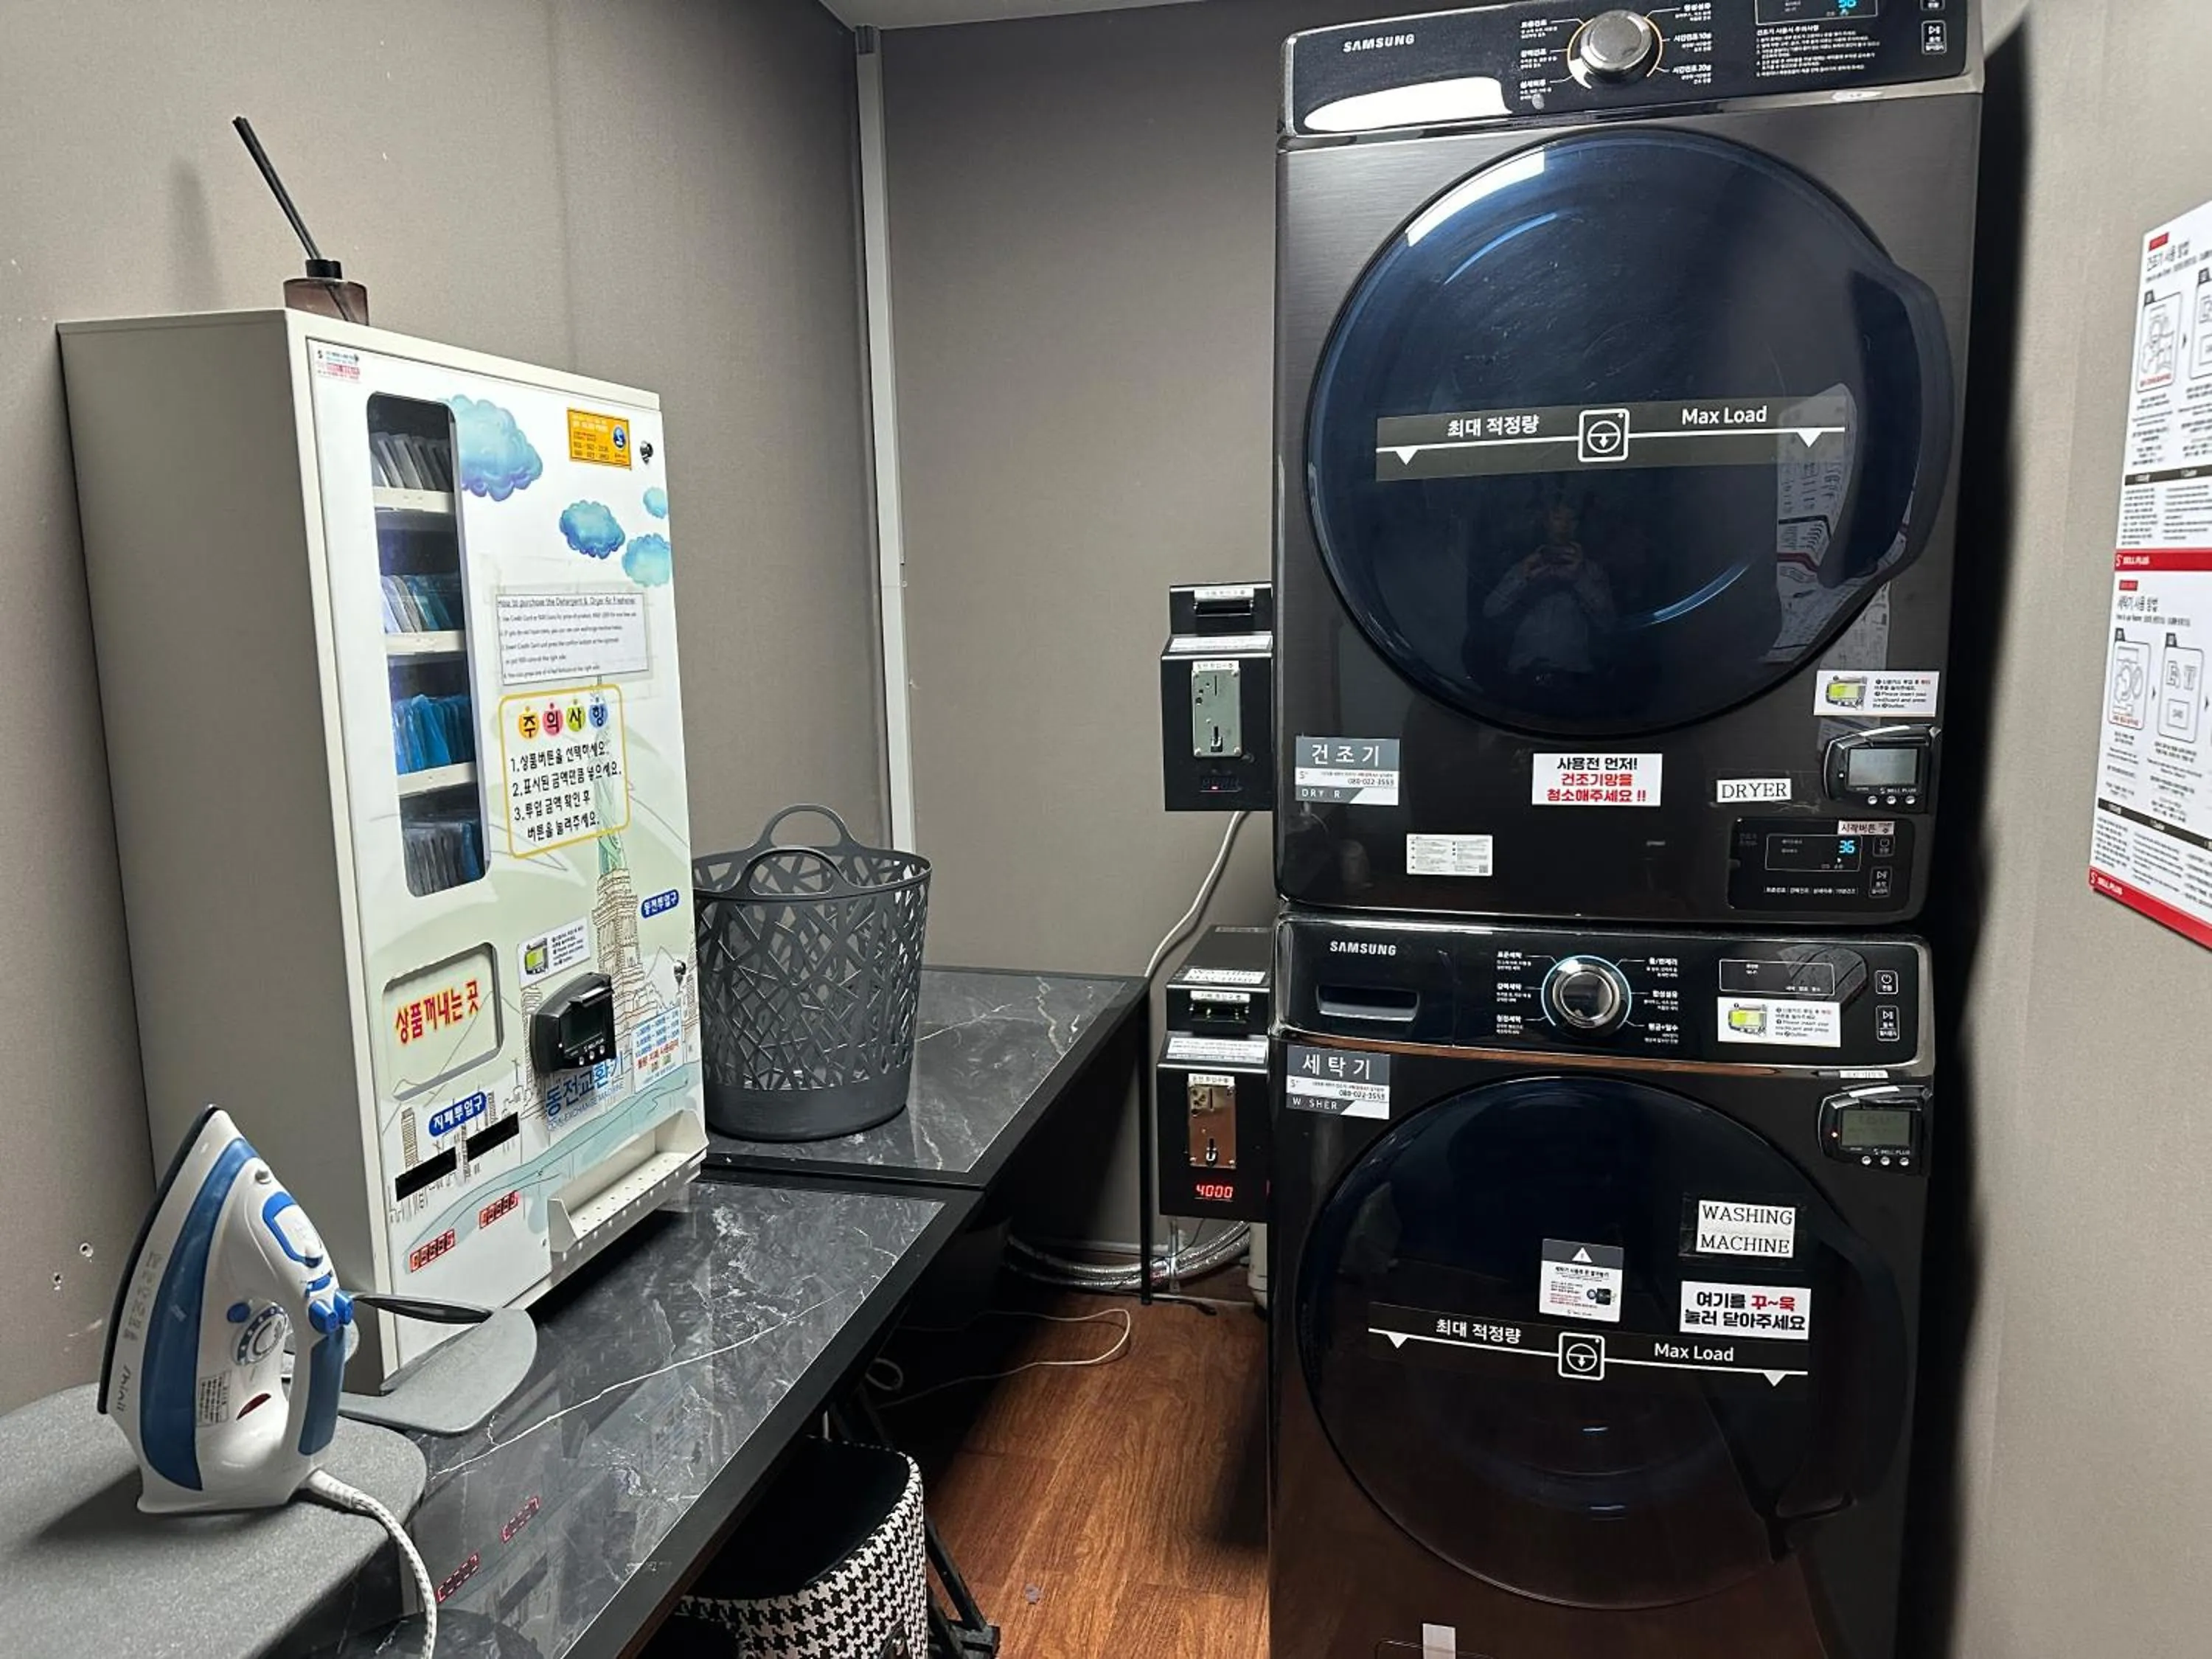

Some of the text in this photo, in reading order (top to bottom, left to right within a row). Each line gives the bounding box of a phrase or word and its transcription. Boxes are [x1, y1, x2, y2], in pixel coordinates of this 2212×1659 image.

[1343, 33, 1415, 52] SAMSUNG
[1682, 405, 1767, 425] Max Load
[1447, 414, 1540, 437] 최대 적정량
[523, 706, 605, 738] 주의사항
[1557, 757, 1638, 771] 사용전 먼저!
[1562, 773, 1632, 787] 건조기망을
[1722, 782, 1787, 799] DRYER
[545, 797, 563, 815] 금액
[565, 791, 581, 809] 확인
[582, 789, 591, 805] 후
[527, 821, 554, 843] 버튼을
[1838, 840, 1856, 854] 36
[1330, 940, 1397, 956] SAMSUNG
[466, 980, 479, 1015] 곳
[1196, 1184, 1234, 1198] 4000
[1702, 1204, 1793, 1225] WASHING
[1700, 1234, 1790, 1254] MACHINE
[1697, 1291, 1795, 1312] 여기를 꾸~욱
[1684, 1309, 1806, 1330] 눌러 닫아주세요
[1436, 1318, 1522, 1344] 최대 적정량
[1655, 1342, 1734, 1362] Max Load
